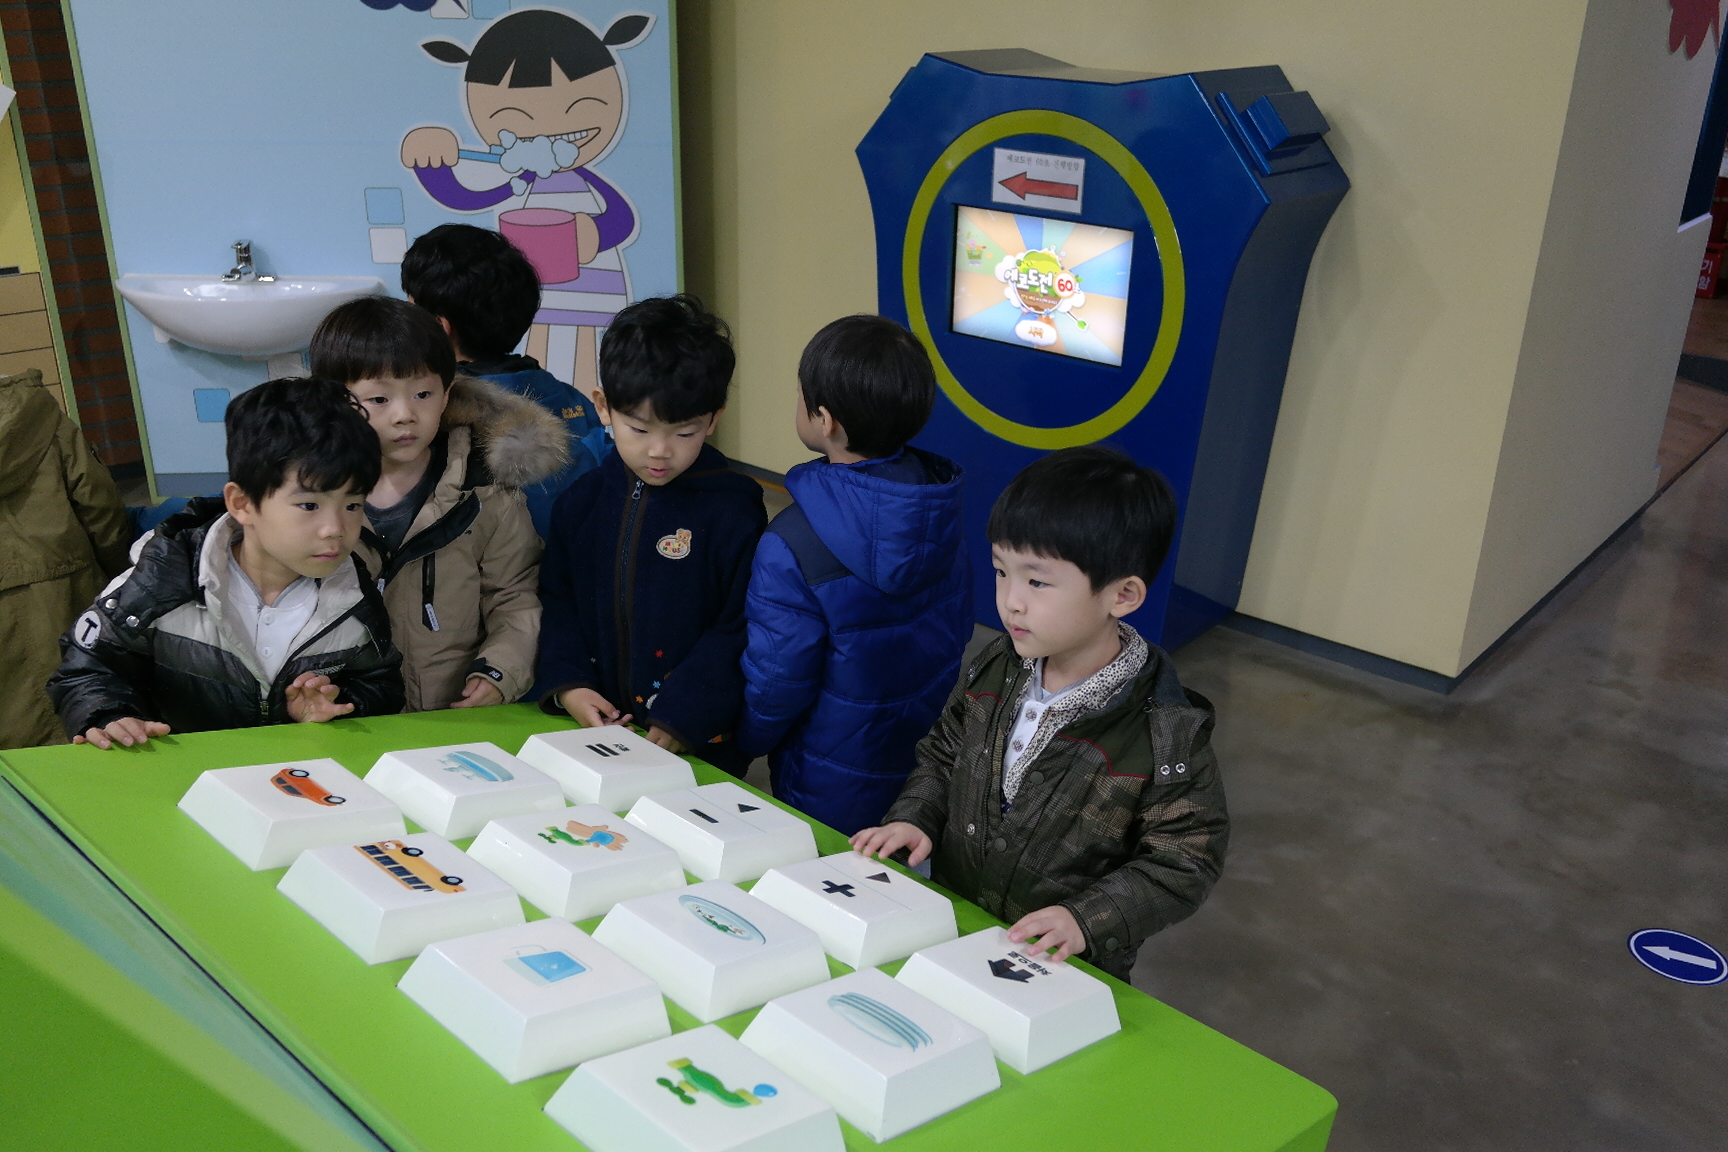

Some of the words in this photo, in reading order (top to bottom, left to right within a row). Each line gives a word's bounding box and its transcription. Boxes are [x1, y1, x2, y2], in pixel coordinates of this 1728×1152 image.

[1003, 268, 1053, 295] 에코도전
[81, 617, 98, 642] T
[1007, 950, 1052, 976] 처음으로
